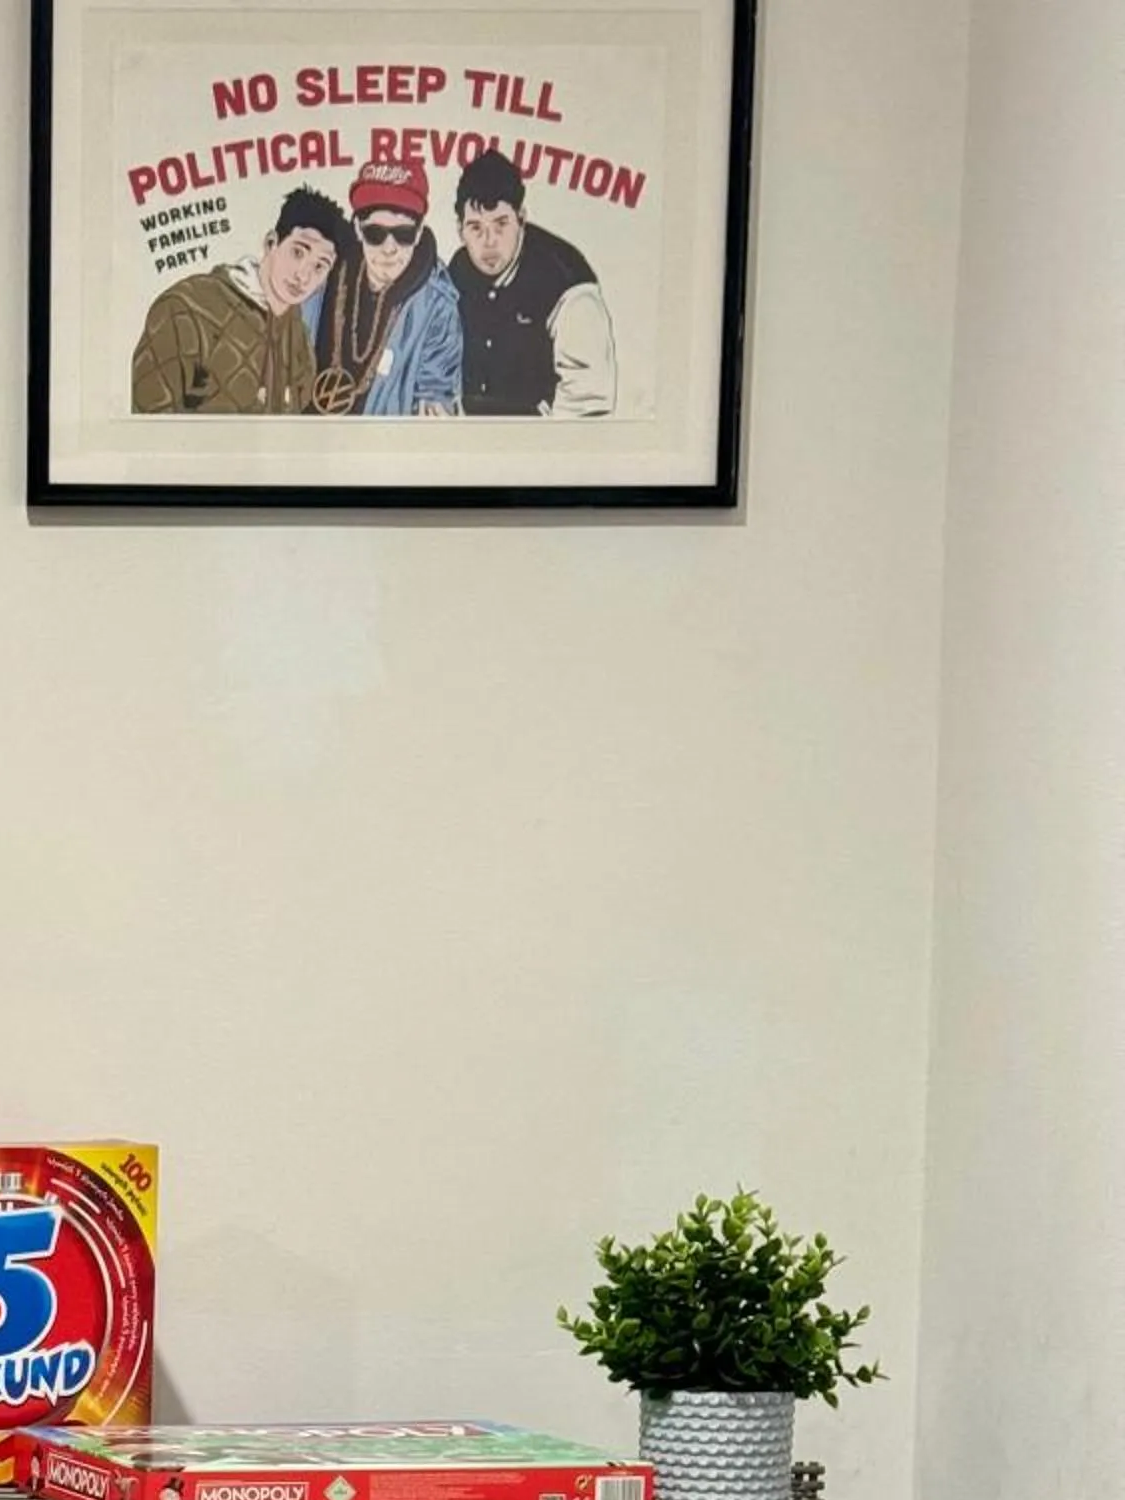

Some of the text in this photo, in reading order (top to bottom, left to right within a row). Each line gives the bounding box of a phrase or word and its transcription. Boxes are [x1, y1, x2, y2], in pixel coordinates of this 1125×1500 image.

[212, 65, 562, 123] NO SLEEP TILL
[127, 129, 354, 206] POLITICAL
[139, 196, 228, 233] WORKING
[147, 218, 232, 253] FAMILIES
[154, 244, 209, 274] PARTY
[118, 1151, 152, 1193] 100
[48, 1456, 110, 1500] MONOPOLY
